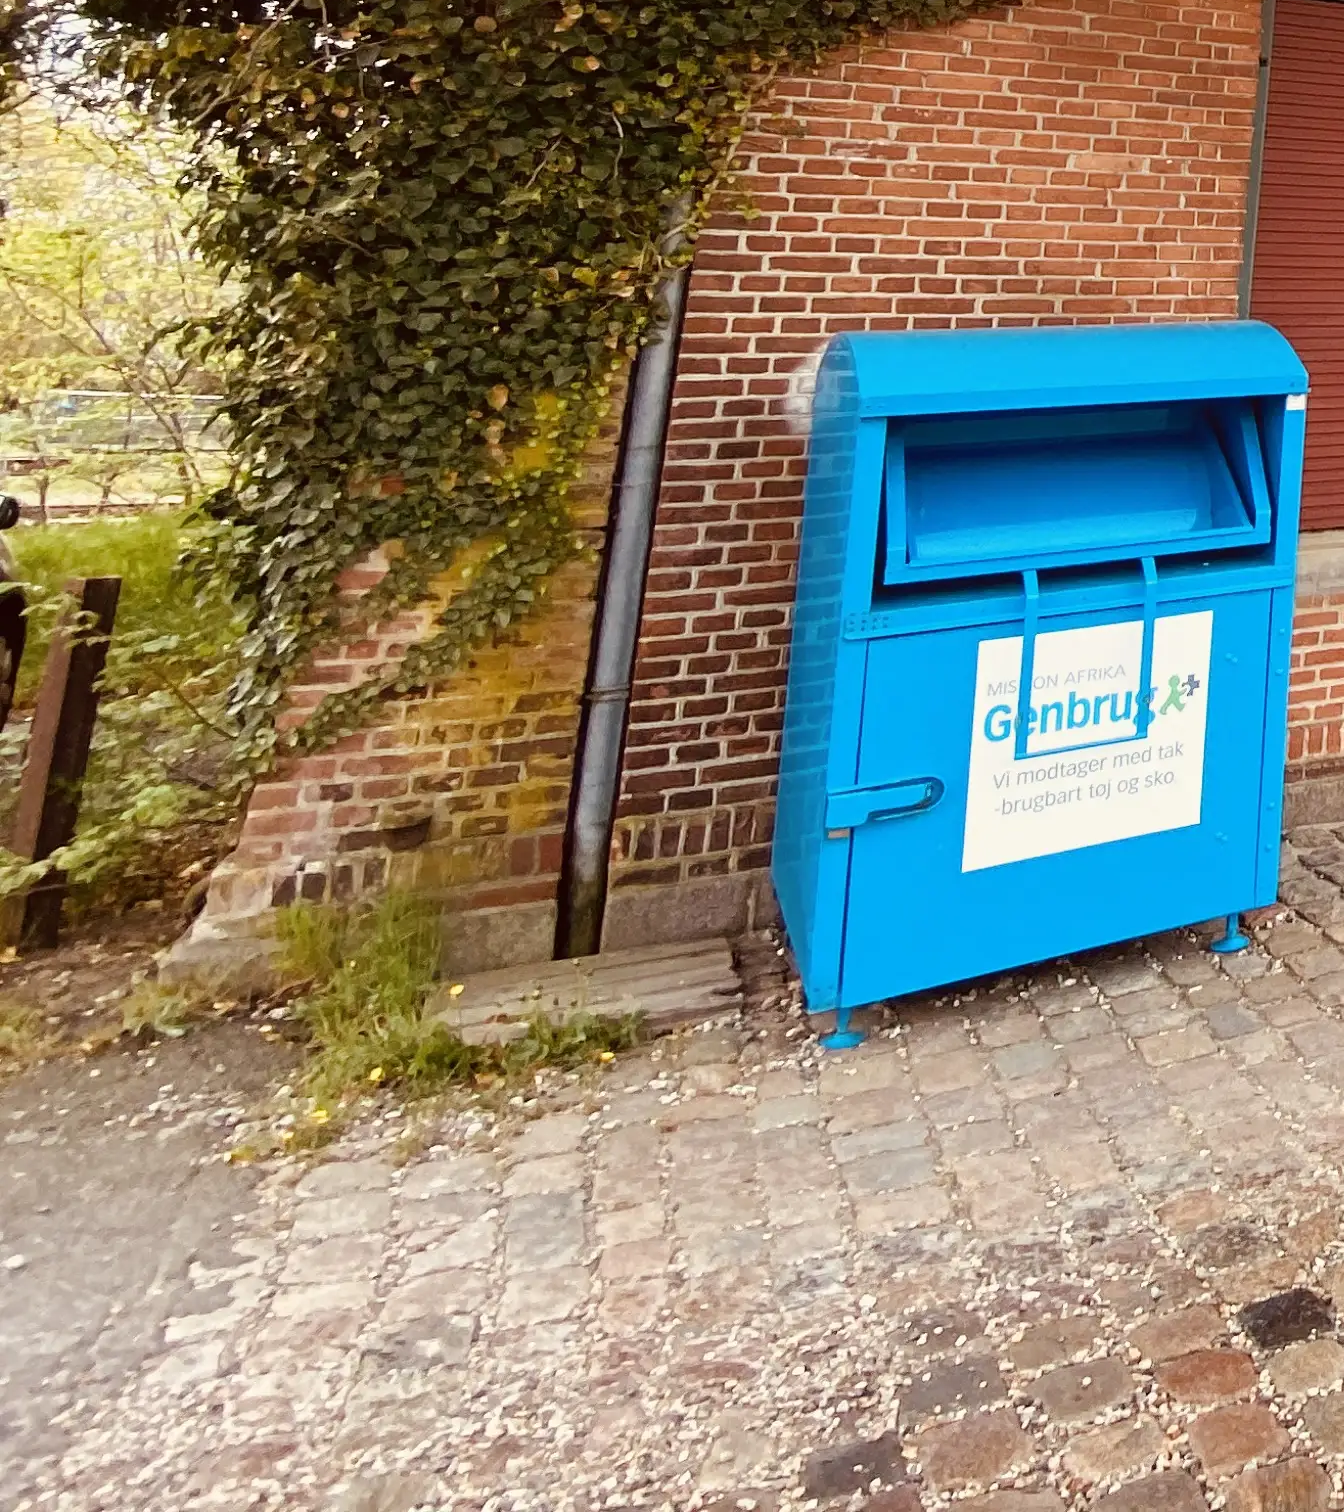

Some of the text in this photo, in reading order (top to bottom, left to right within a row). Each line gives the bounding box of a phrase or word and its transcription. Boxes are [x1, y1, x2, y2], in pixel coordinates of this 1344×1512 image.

[987, 664, 1126, 696] MISON AFRIKA
[993, 741, 1185, 790] Vi modtager med tak
[1089, 779, 1113, 800] tøj
[1117, 776, 1139, 794] og
[1144, 770, 1175, 789] sko
